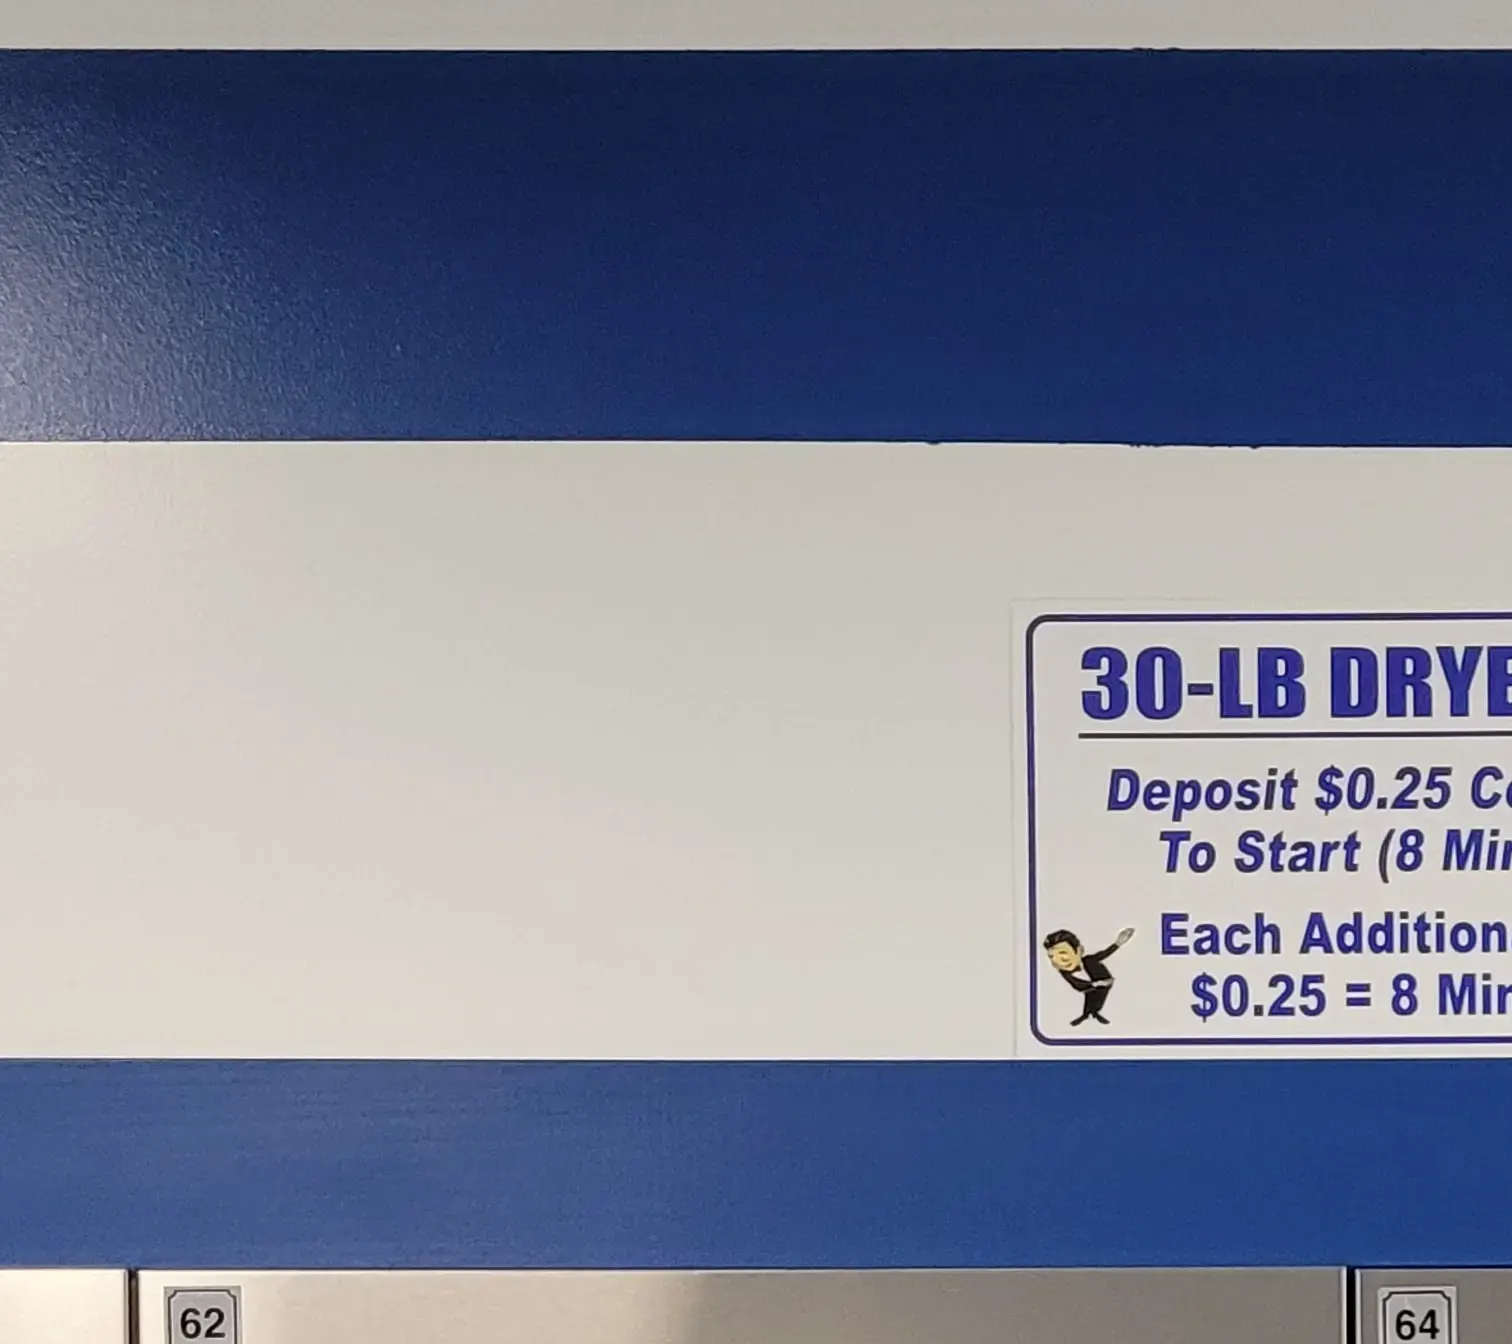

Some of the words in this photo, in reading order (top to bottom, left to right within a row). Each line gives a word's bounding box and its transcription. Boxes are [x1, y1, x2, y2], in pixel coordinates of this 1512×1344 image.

[1080, 645, 1306, 721] 30-LB
[1106, 767, 1298, 822] Deposit
[1313, 765, 1452, 815] $0.25
[1159, 830, 1216, 873] To
[1233, 830, 1361, 873] Start
[1378, 828, 1424, 883] (8
[1160, 912, 1281, 956] Each
[1191, 973, 1327, 1022] $0.25
[1345, 982, 1372, 1008] =
[1390, 974, 1418, 1016] 8
[180, 1307, 226, 1339] 62
[1395, 1309, 1440, 1341] 64
